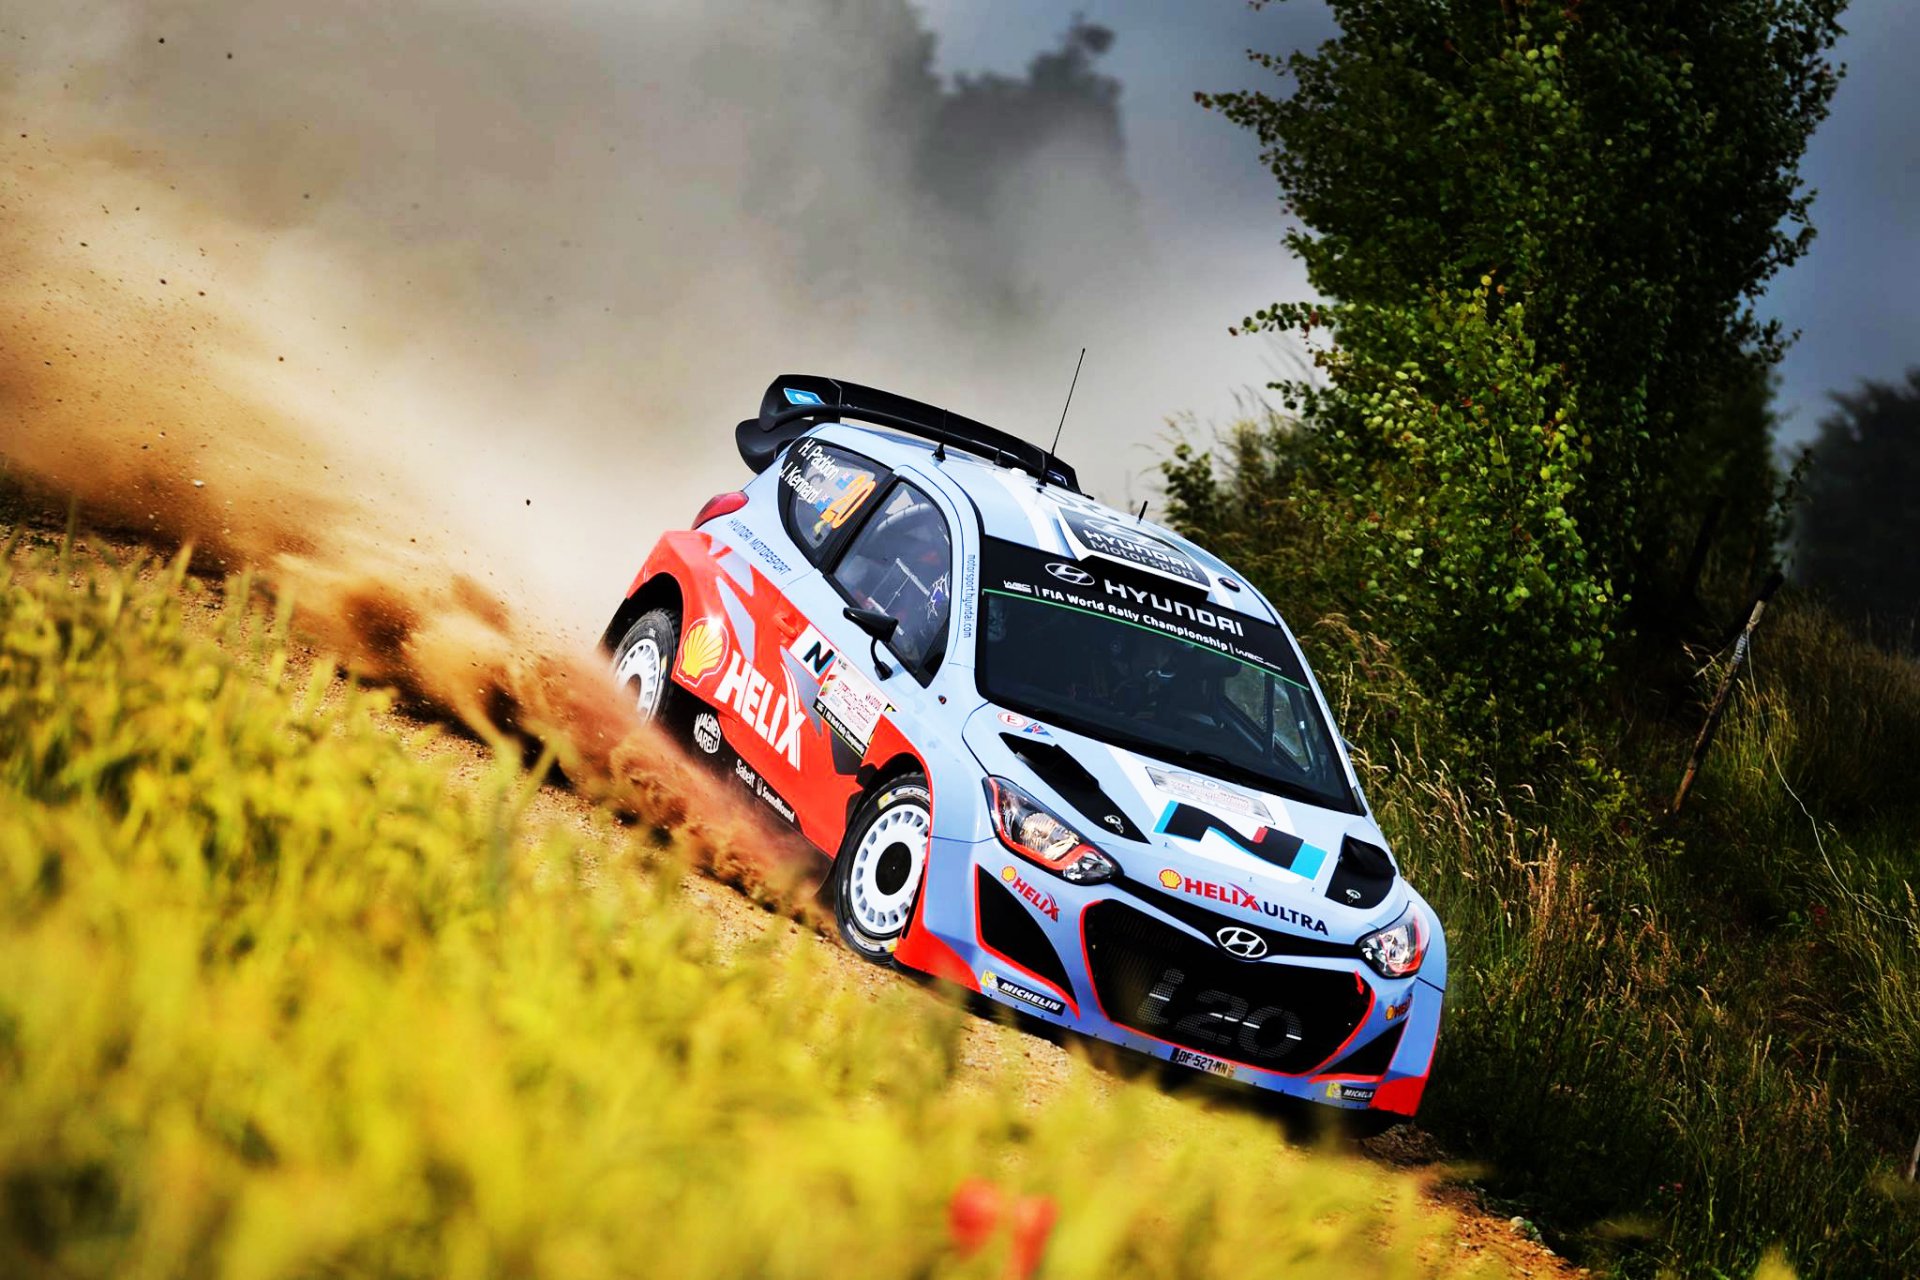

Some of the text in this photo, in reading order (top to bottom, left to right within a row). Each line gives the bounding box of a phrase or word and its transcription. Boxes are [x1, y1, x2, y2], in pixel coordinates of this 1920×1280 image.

[798, 438, 840, 481] H. Paddon
[820, 474, 877, 530] 20
[727, 518, 792, 576] HYUNDAI MOTORSPORT
[1083, 529, 1194, 571] HYUNDAI
[1089, 540, 1200, 581] Motorsport
[1042, 588, 1064, 601] FIA
[1066, 593, 1105, 611] World
[1108, 604, 1140, 623] Rally
[1143, 614, 1229, 651] Championship
[1104, 579, 1244, 637] HYUNDAI
[713, 649, 807, 772] HELIX
[1012, 876, 1061, 922] HELIX
[1184, 878, 1330, 937] HELIX ULTRA
[1000, 982, 1061, 1012] MICHELIN
[1177, 1050, 1229, 1074] DF-527-MN
